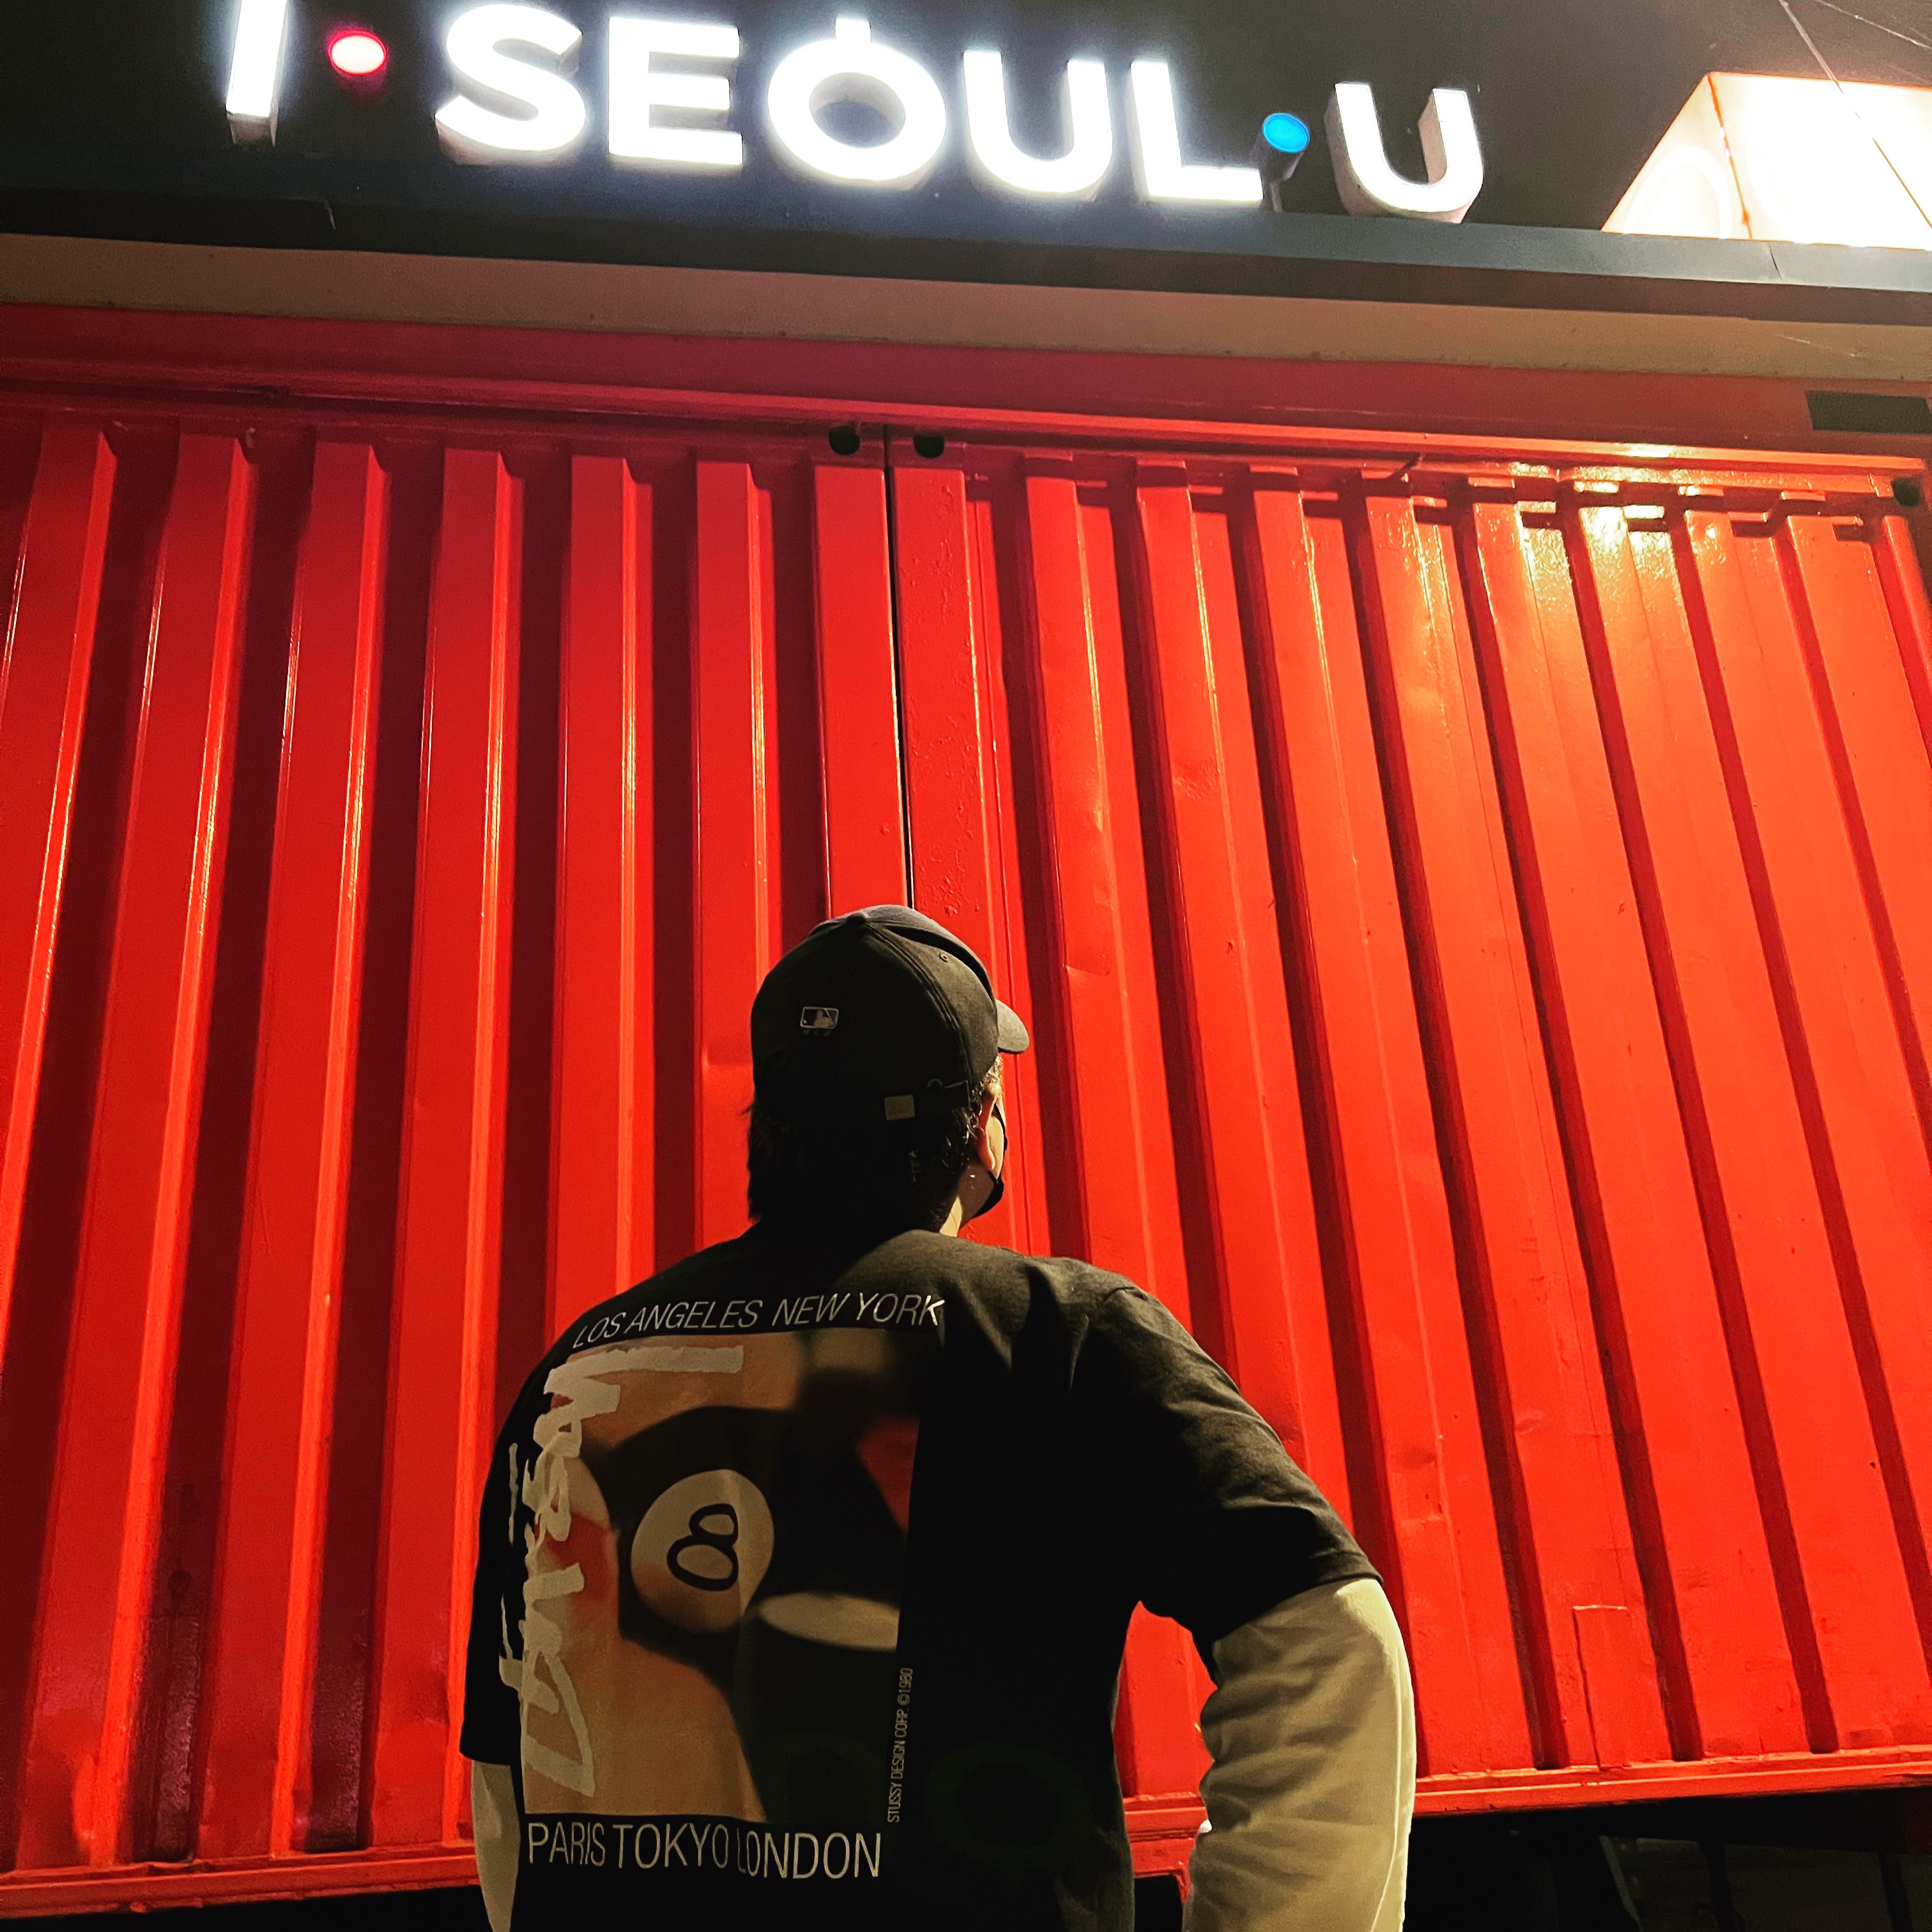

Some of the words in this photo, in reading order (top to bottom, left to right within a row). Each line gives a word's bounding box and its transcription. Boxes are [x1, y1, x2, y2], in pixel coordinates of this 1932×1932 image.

[1329, 82, 1484, 218] U
[572, 1311, 627, 1349] LOS
[624, 1300, 763, 1334] ANGELES
[772, 1292, 851, 1327] NEW
[856, 1292, 946, 1326] YORK
[667, 1503, 739, 1591] 8
[891, 1740, 906, 1779] DESIGN
[528, 1821, 605, 1867] PARIS
[612, 1822, 729, 1869] TOKYO
[735, 1827, 882, 1880] LONDON
